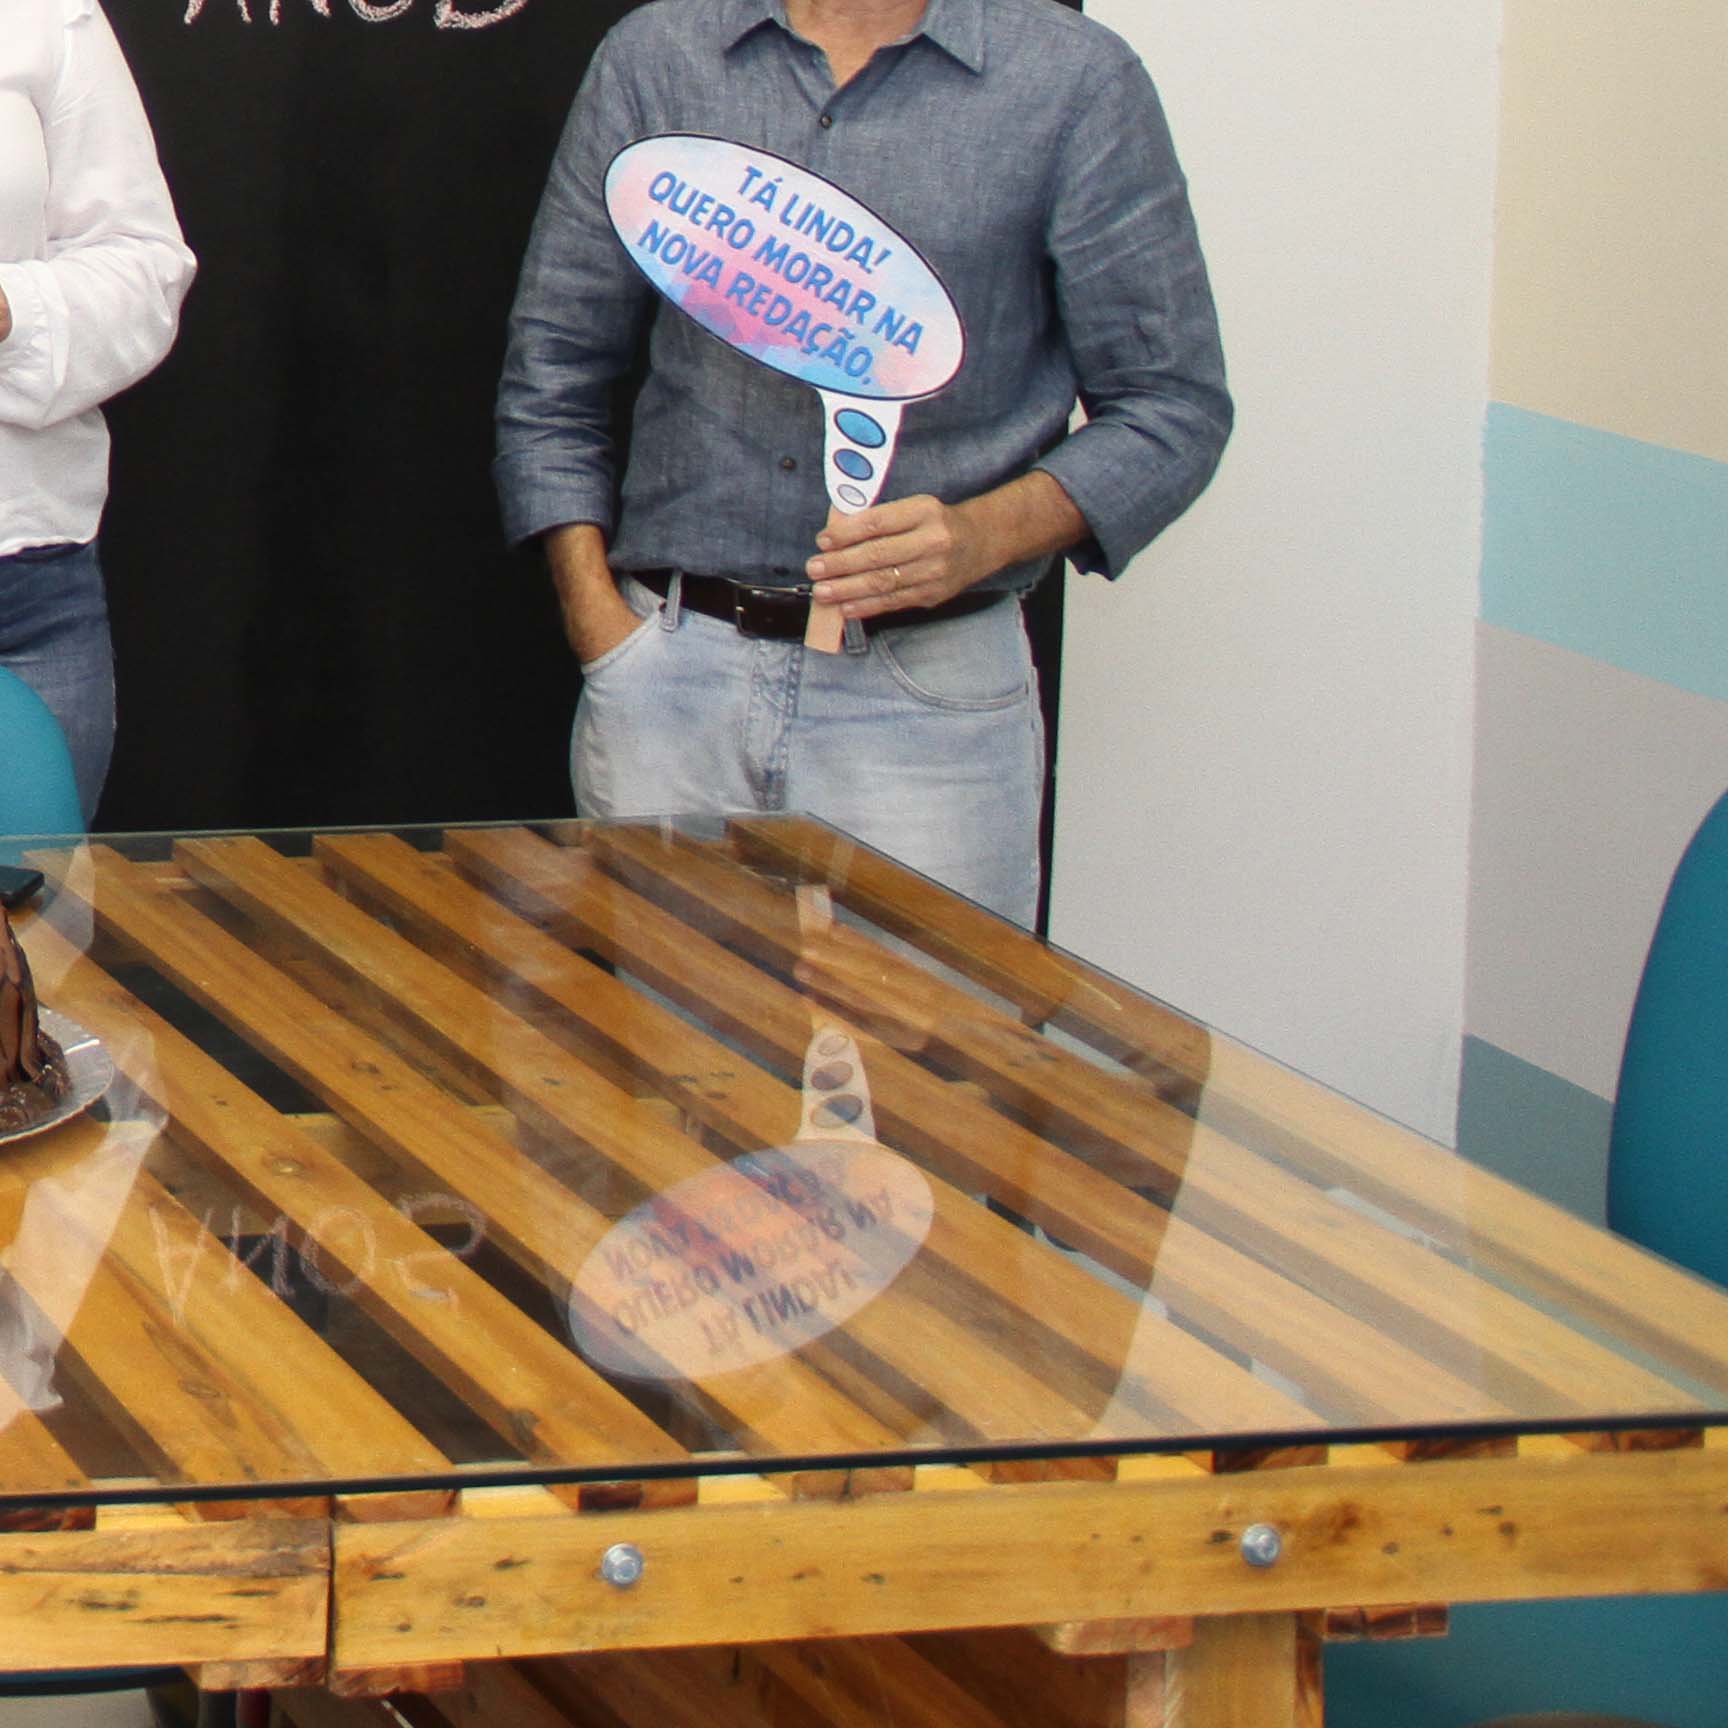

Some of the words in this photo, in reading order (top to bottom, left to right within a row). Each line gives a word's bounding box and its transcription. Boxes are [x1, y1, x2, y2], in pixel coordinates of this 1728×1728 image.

[637, 219, 724, 290] NOVA
[647, 170, 756, 250] QUERO
[751, 234, 878, 325] MORAR
[872, 305, 925, 356] NA
[736, 165, 784, 213] TÁ
[779, 194, 893, 275] LINDA!
